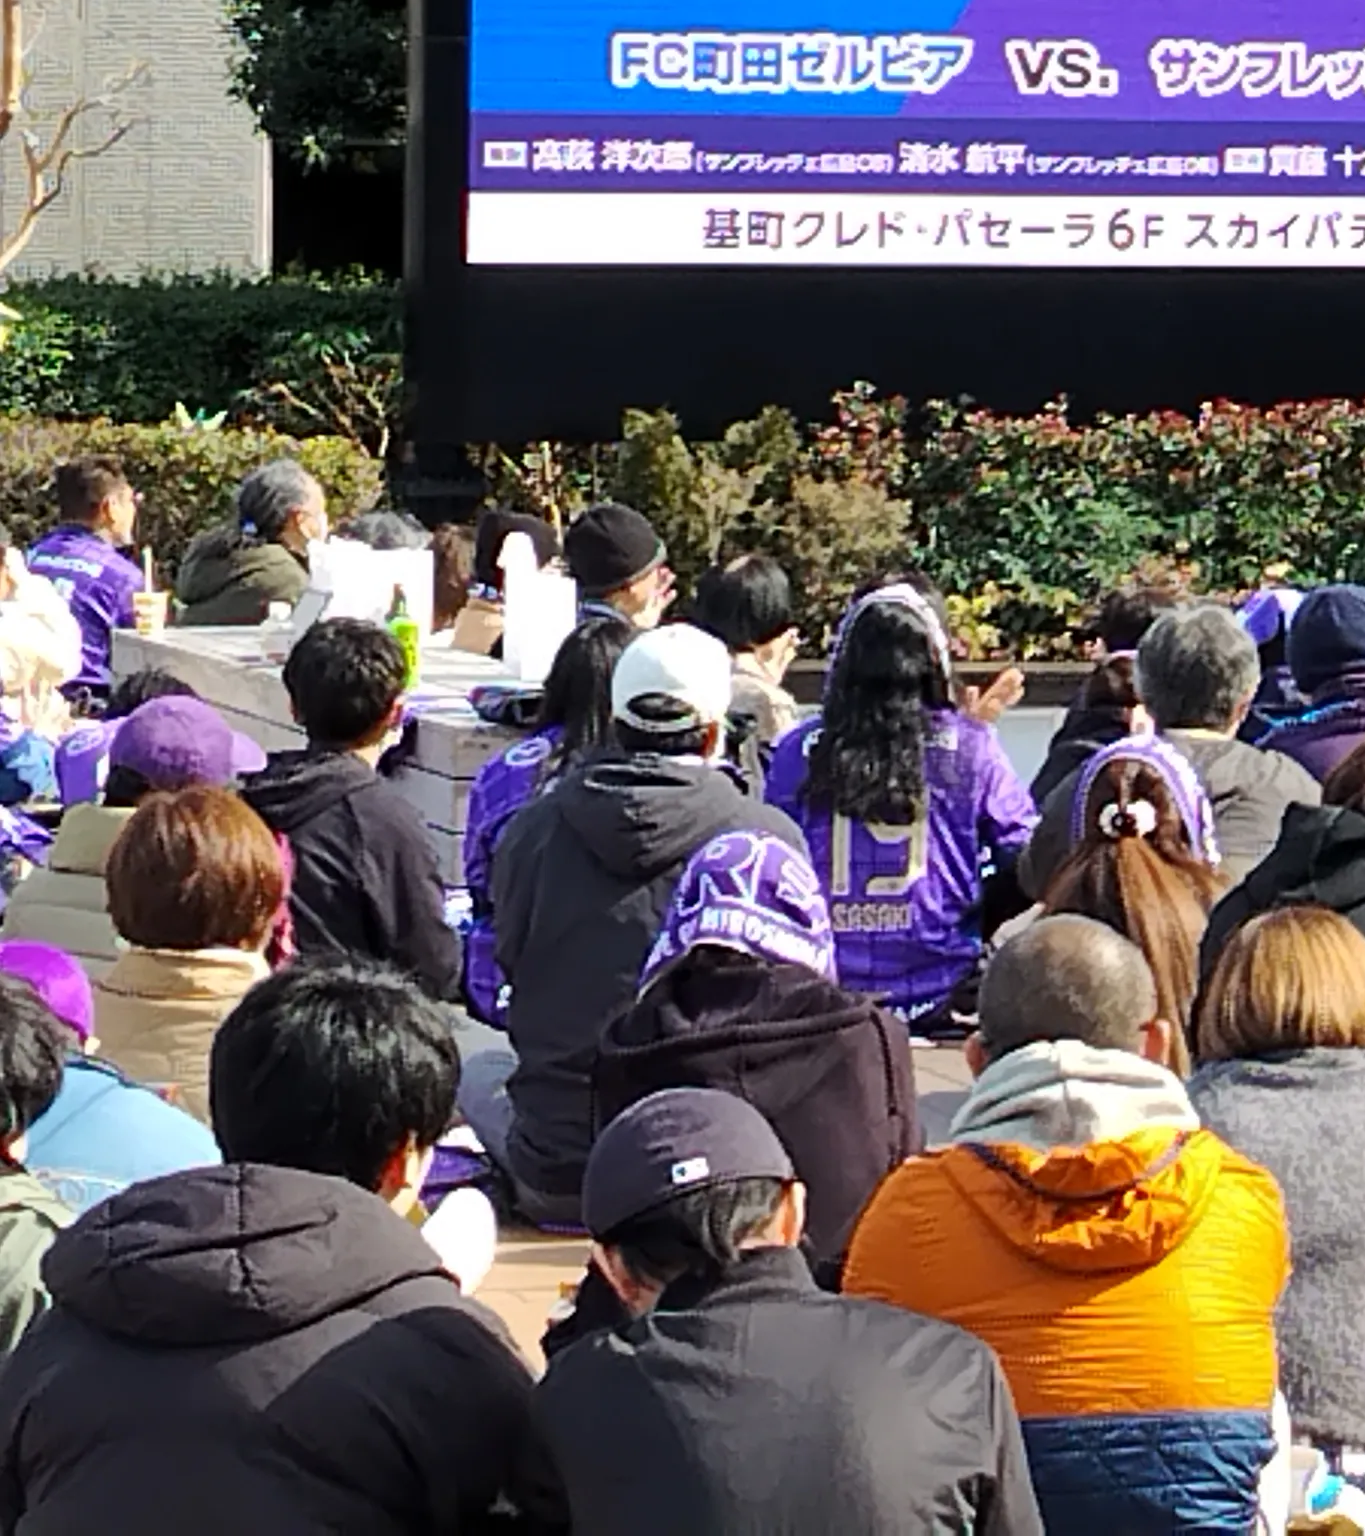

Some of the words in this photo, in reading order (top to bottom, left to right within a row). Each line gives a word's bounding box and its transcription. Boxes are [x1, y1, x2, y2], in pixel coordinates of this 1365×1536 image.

[611, 33, 971, 91] FC町田ゼルビア
[702, 208, 1166, 251] 基町クレド・パセーラ6F
